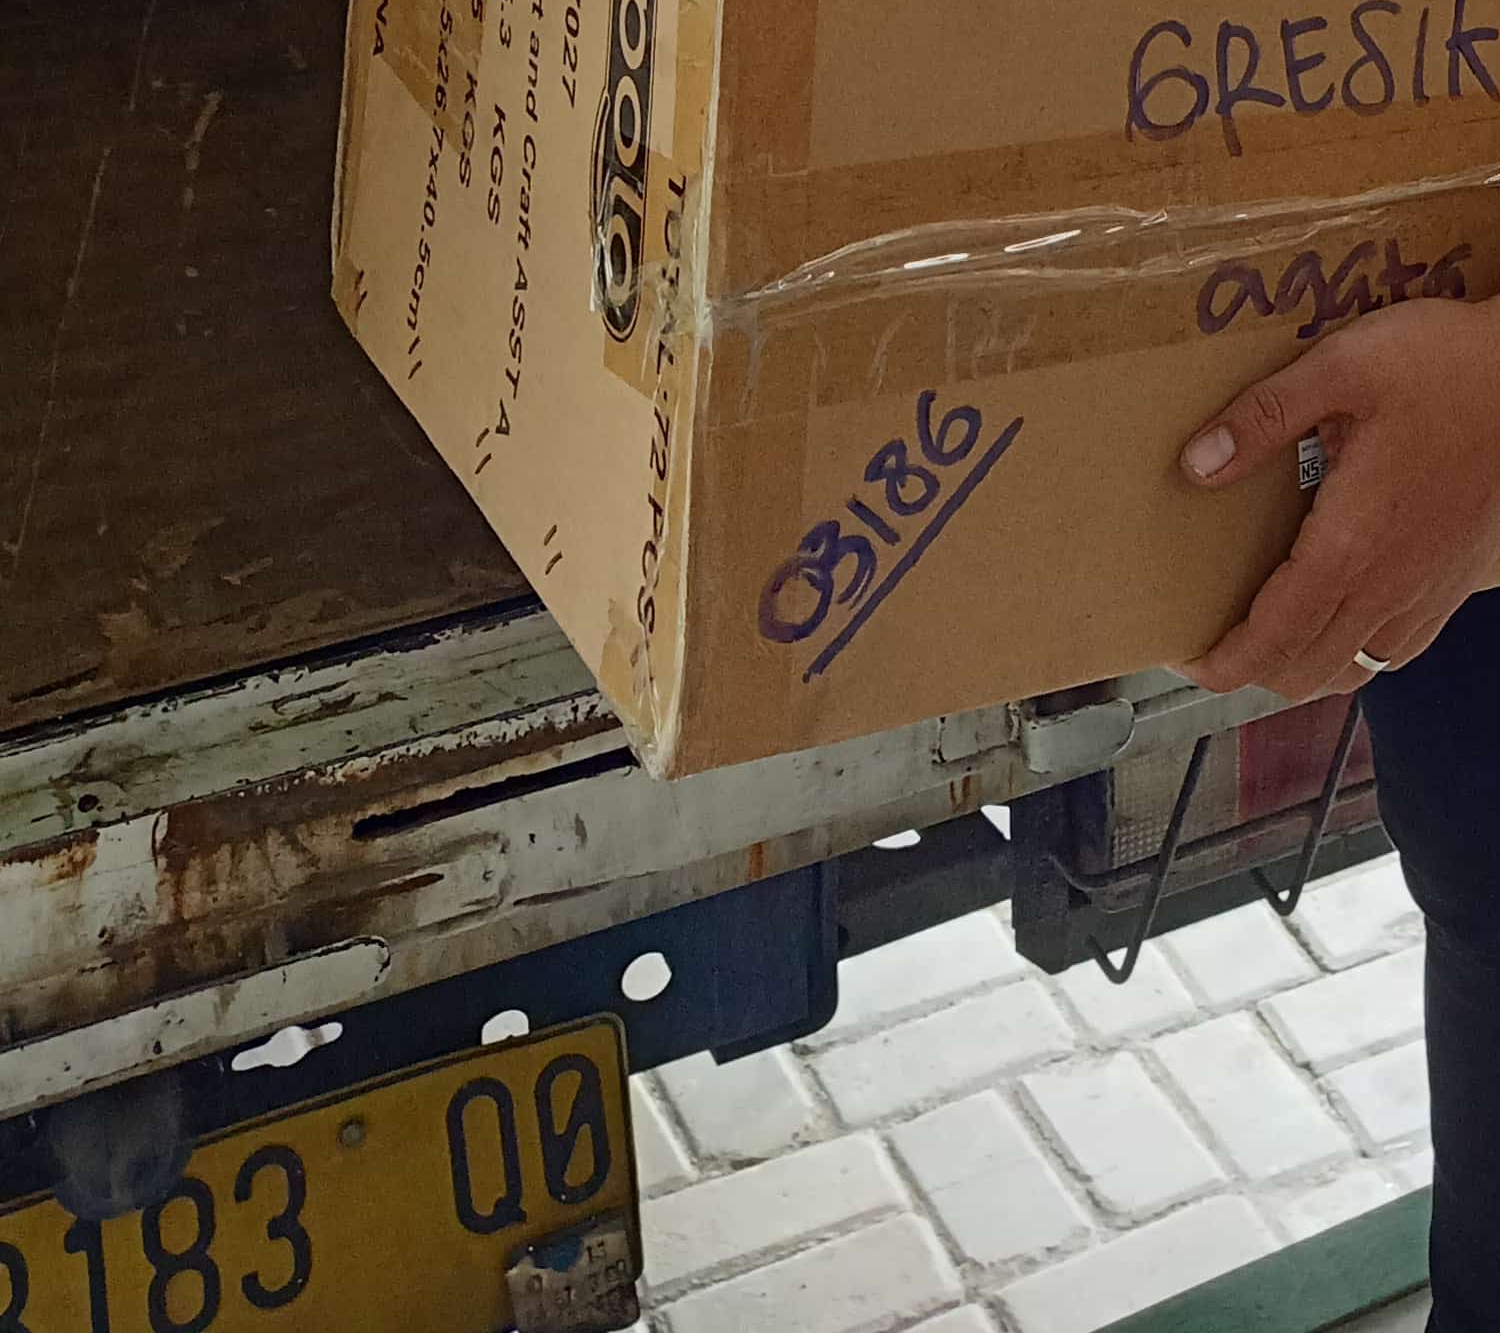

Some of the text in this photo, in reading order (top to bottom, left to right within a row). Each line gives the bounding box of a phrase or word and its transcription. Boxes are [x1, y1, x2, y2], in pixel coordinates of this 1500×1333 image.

[459, 70, 479, 188] KGS
[525, 31, 540, 122] and
[487, 103, 507, 226] KGS
[517, 134, 537, 250] Craft
[505, 257, 528, 399] ASST
[495, 398, 511, 436] A
